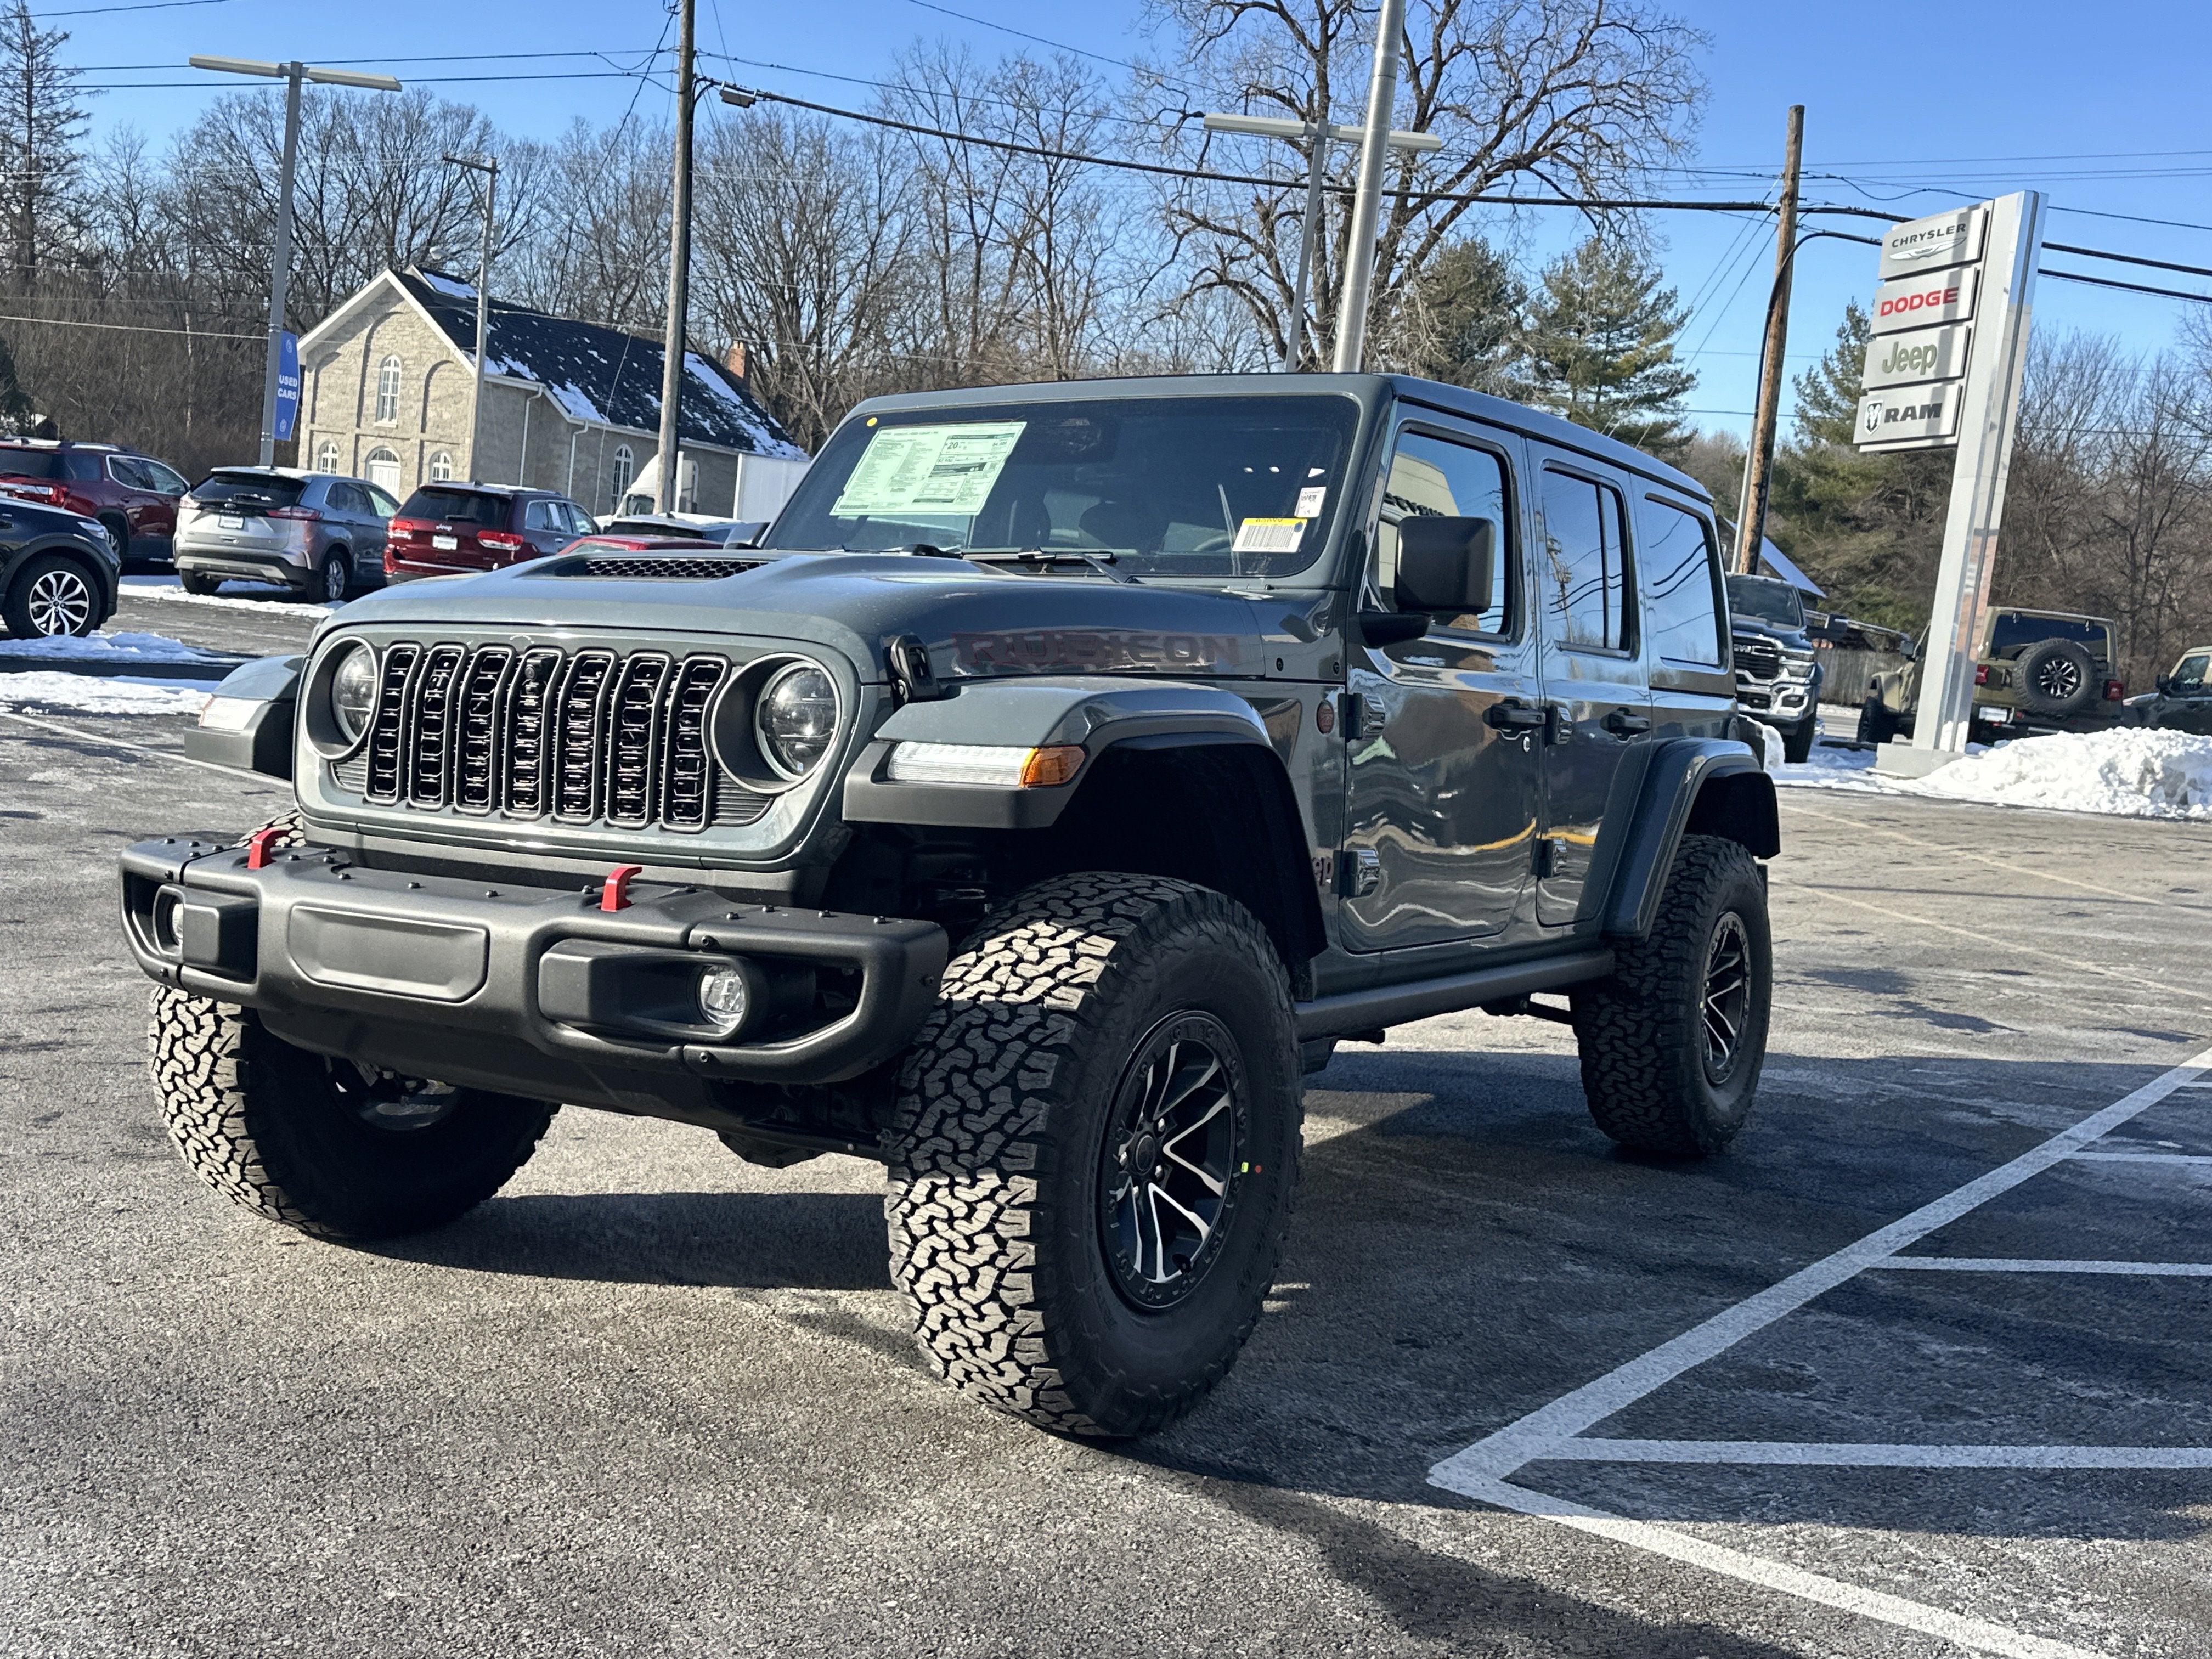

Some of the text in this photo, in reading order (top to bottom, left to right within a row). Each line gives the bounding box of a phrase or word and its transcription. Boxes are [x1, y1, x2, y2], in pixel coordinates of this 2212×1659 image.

[1892, 223, 1966, 248] CHRYSLER
[1880, 287, 1959, 316] DODGE
[1882, 342, 1937, 375] Jeep
[279, 375, 298, 387] USED
[278, 388, 297, 400] CARS
[1884, 403, 1943, 423] RAM
[951, 633, 1239, 665] RUBICON
